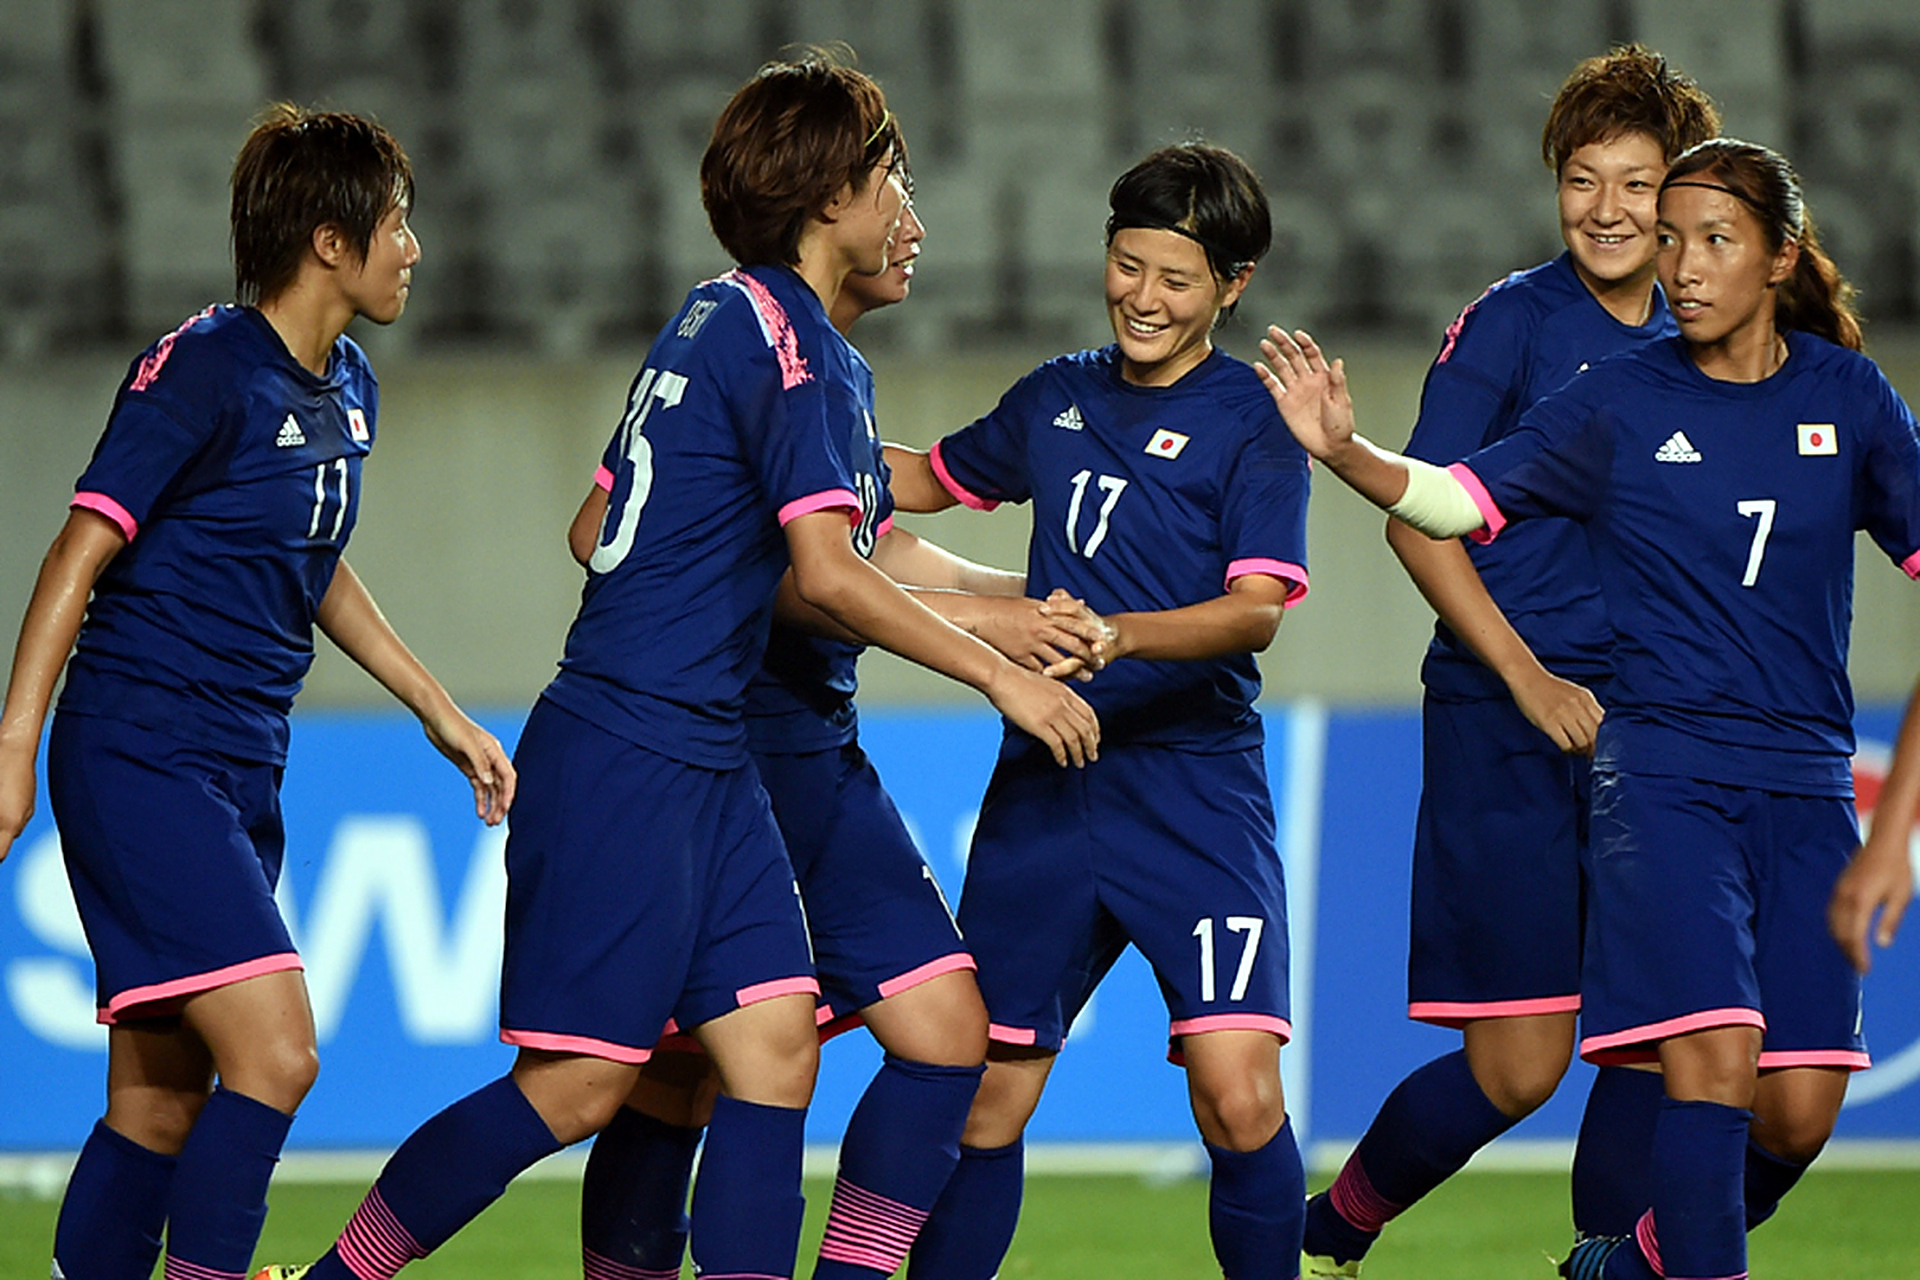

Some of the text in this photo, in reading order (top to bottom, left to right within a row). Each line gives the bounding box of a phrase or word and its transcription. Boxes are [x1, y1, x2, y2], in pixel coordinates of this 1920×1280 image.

[307, 457, 347, 540] 11
[589, 367, 689, 574] 15
[1066, 469, 1128, 558] 17
[1737, 499, 1776, 586] 7
[1192, 916, 1264, 1002] 17
